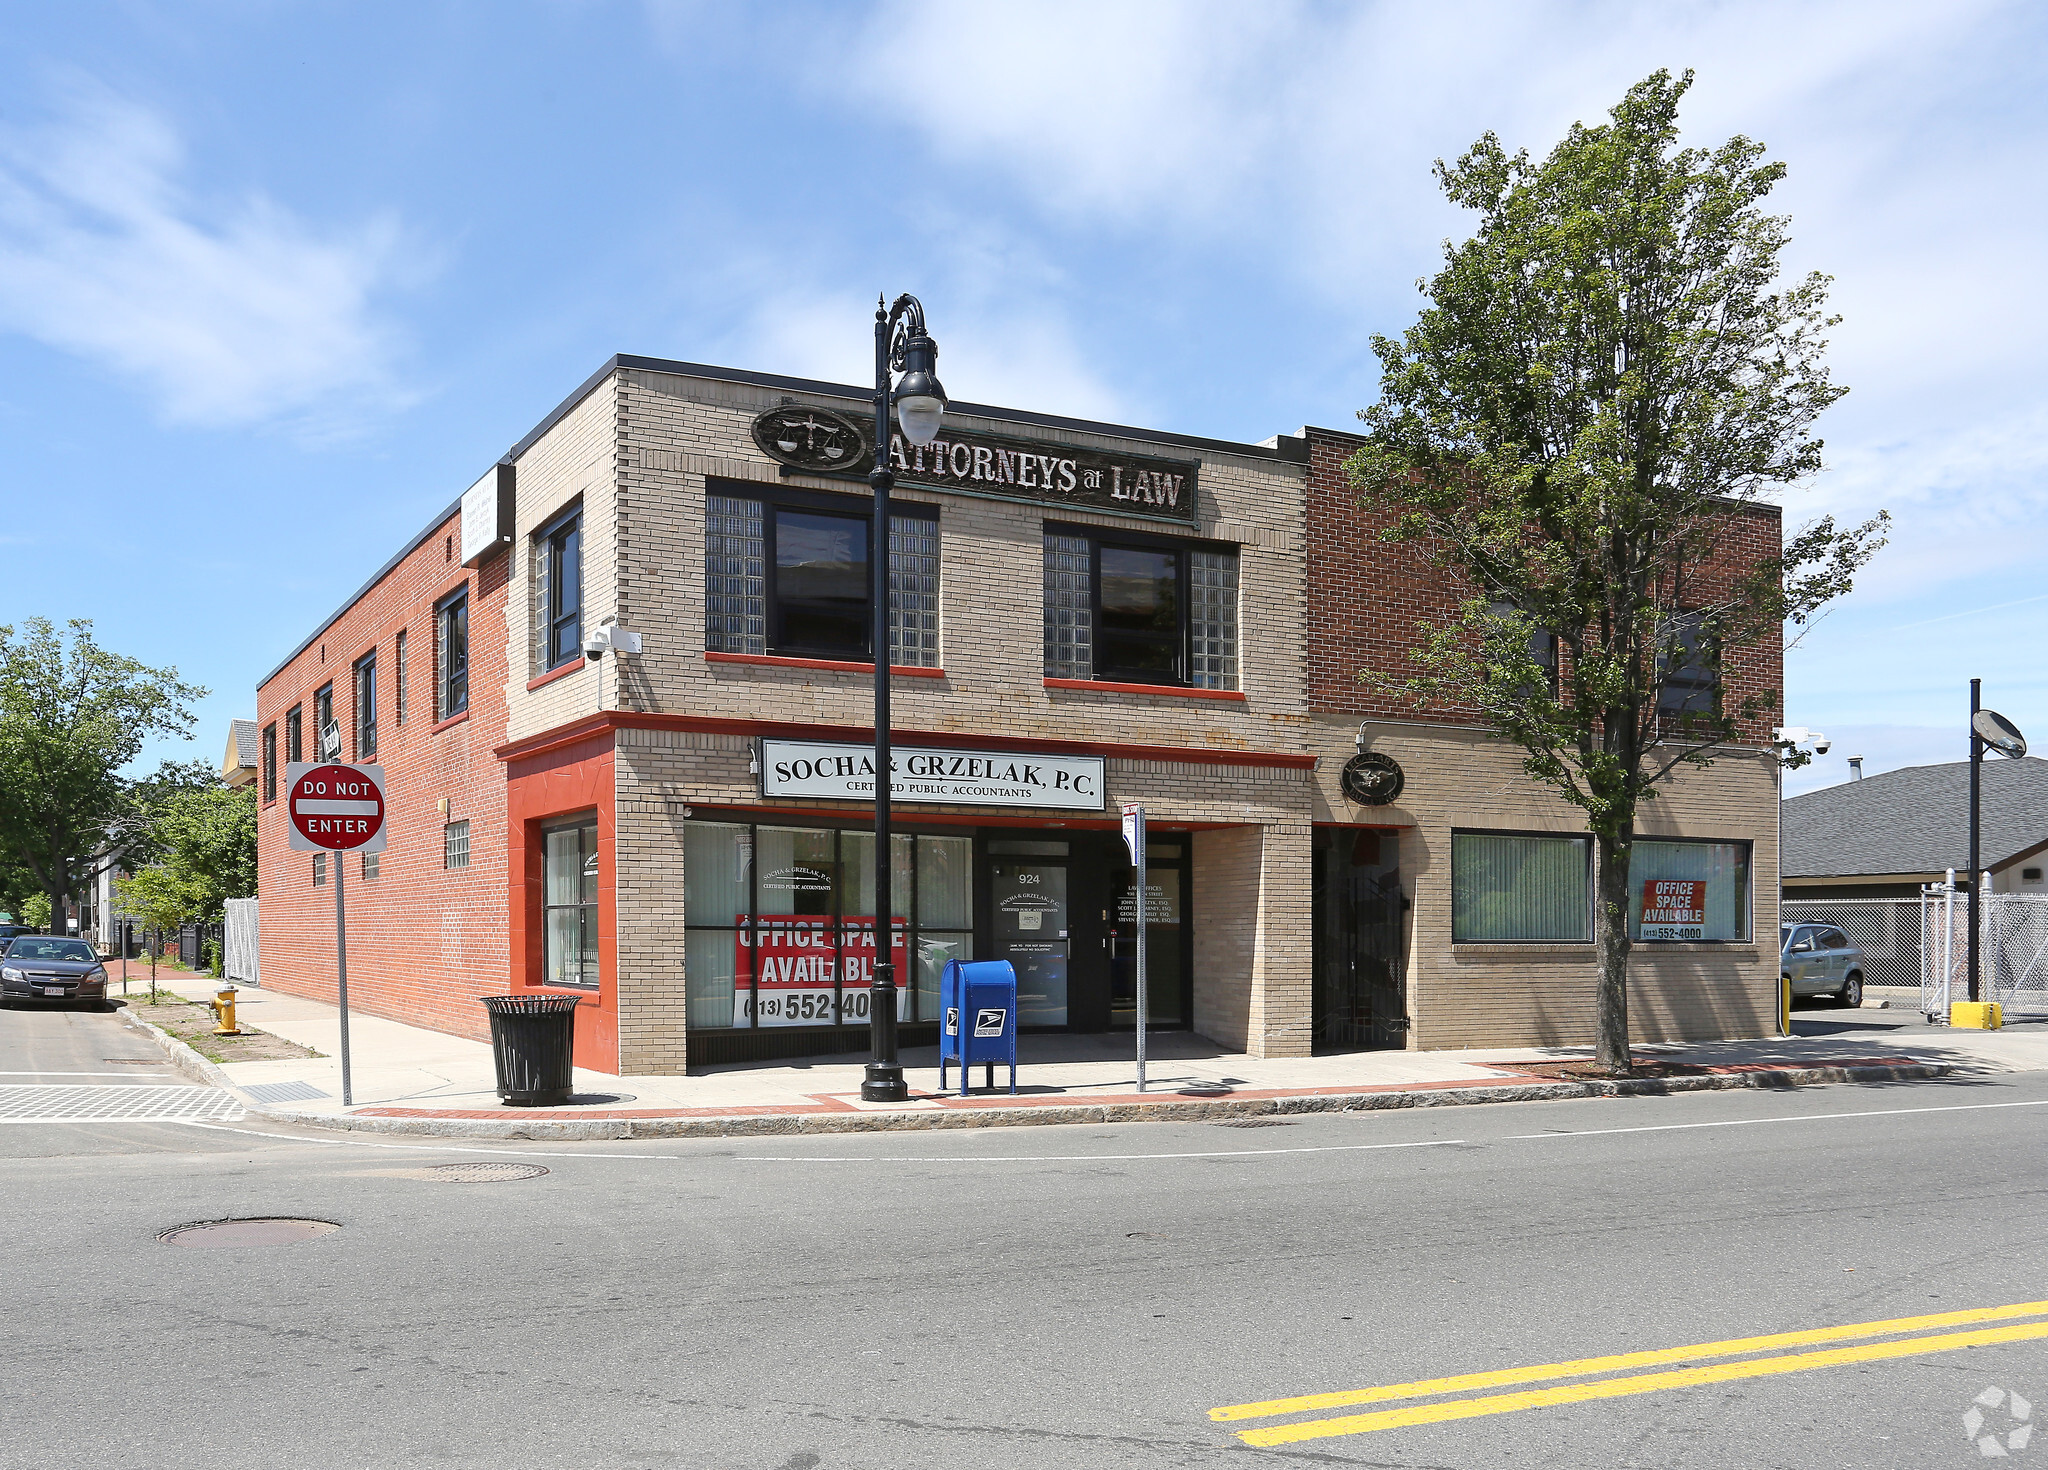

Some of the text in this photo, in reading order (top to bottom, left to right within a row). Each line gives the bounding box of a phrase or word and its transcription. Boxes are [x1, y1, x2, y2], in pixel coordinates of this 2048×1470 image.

[889, 433, 1076, 492] ATTORNEYS
[1110, 465, 1184, 507] LAW
[774, 755, 876, 782] SOCHA
[907, 754, 1047, 789] GRZELAK,
[1053, 769, 1095, 796] P.C.
[303, 781, 370, 796] DO NOT
[846, 781, 1033, 798] CERTED PUBLIC ACCOUNTANTS
[308, 819, 368, 833] ENTER
[763, 868, 785, 881] SOCHA
[791, 866, 821, 878] GRZELAK,
[1019, 874, 1040, 884] 924
[1656, 882, 1694, 895] OFFICE
[1656, 895, 1691, 909] SPACE
[1644, 908, 1702, 922] AVAILABLE
[739, 921, 904, 948] OFFICE SPAE
[1643, 927, 1702, 939] (413) 552-4000
[761, 956, 877, 983] AVAILABL
[743, 993, 869, 1020] (13) 552-40
